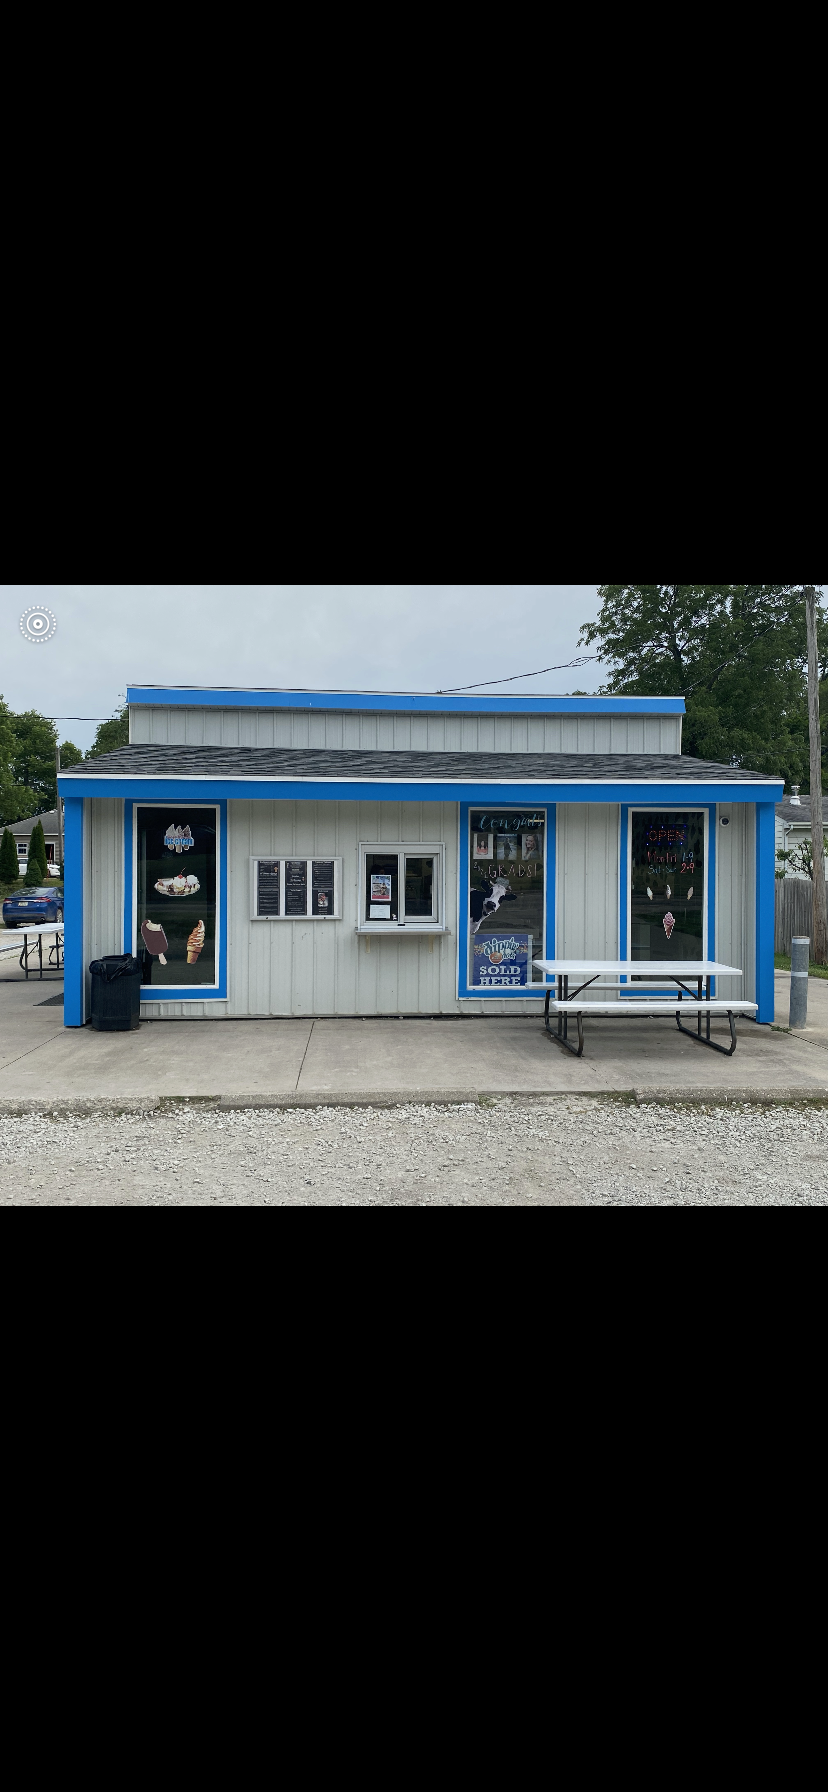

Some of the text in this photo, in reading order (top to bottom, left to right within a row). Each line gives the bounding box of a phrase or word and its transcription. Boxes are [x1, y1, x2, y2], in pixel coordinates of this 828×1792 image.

[649, 829, 685, 841] OPEN
[680, 862, 695, 874] 2-9
[479, 965, 521, 975] SOLD
[479, 976, 521, 986] HERE
